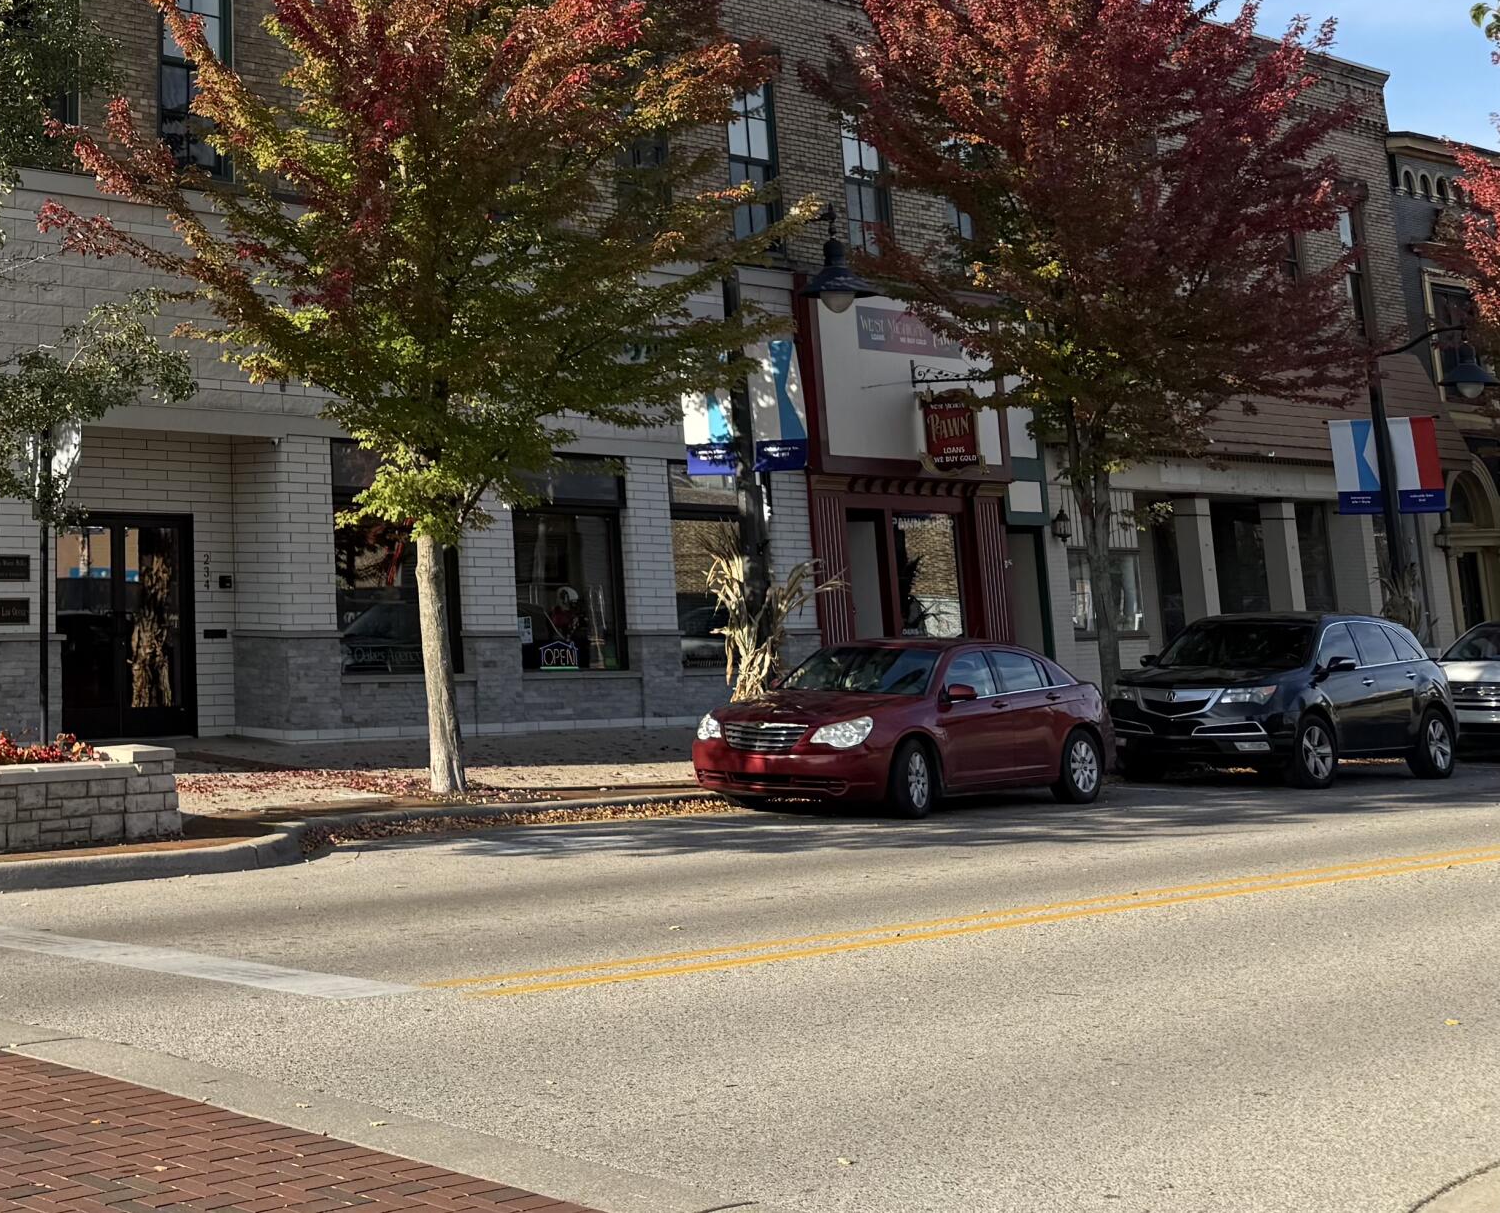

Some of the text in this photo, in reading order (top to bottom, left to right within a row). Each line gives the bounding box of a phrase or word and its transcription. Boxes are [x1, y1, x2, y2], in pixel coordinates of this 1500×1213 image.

[926, 412, 971, 443] PAWN
[943, 446, 965, 454] LOANS
[945, 455, 959, 463] BUY
[960, 454, 977, 462] GOLD
[543, 648, 576, 666] OPEN
